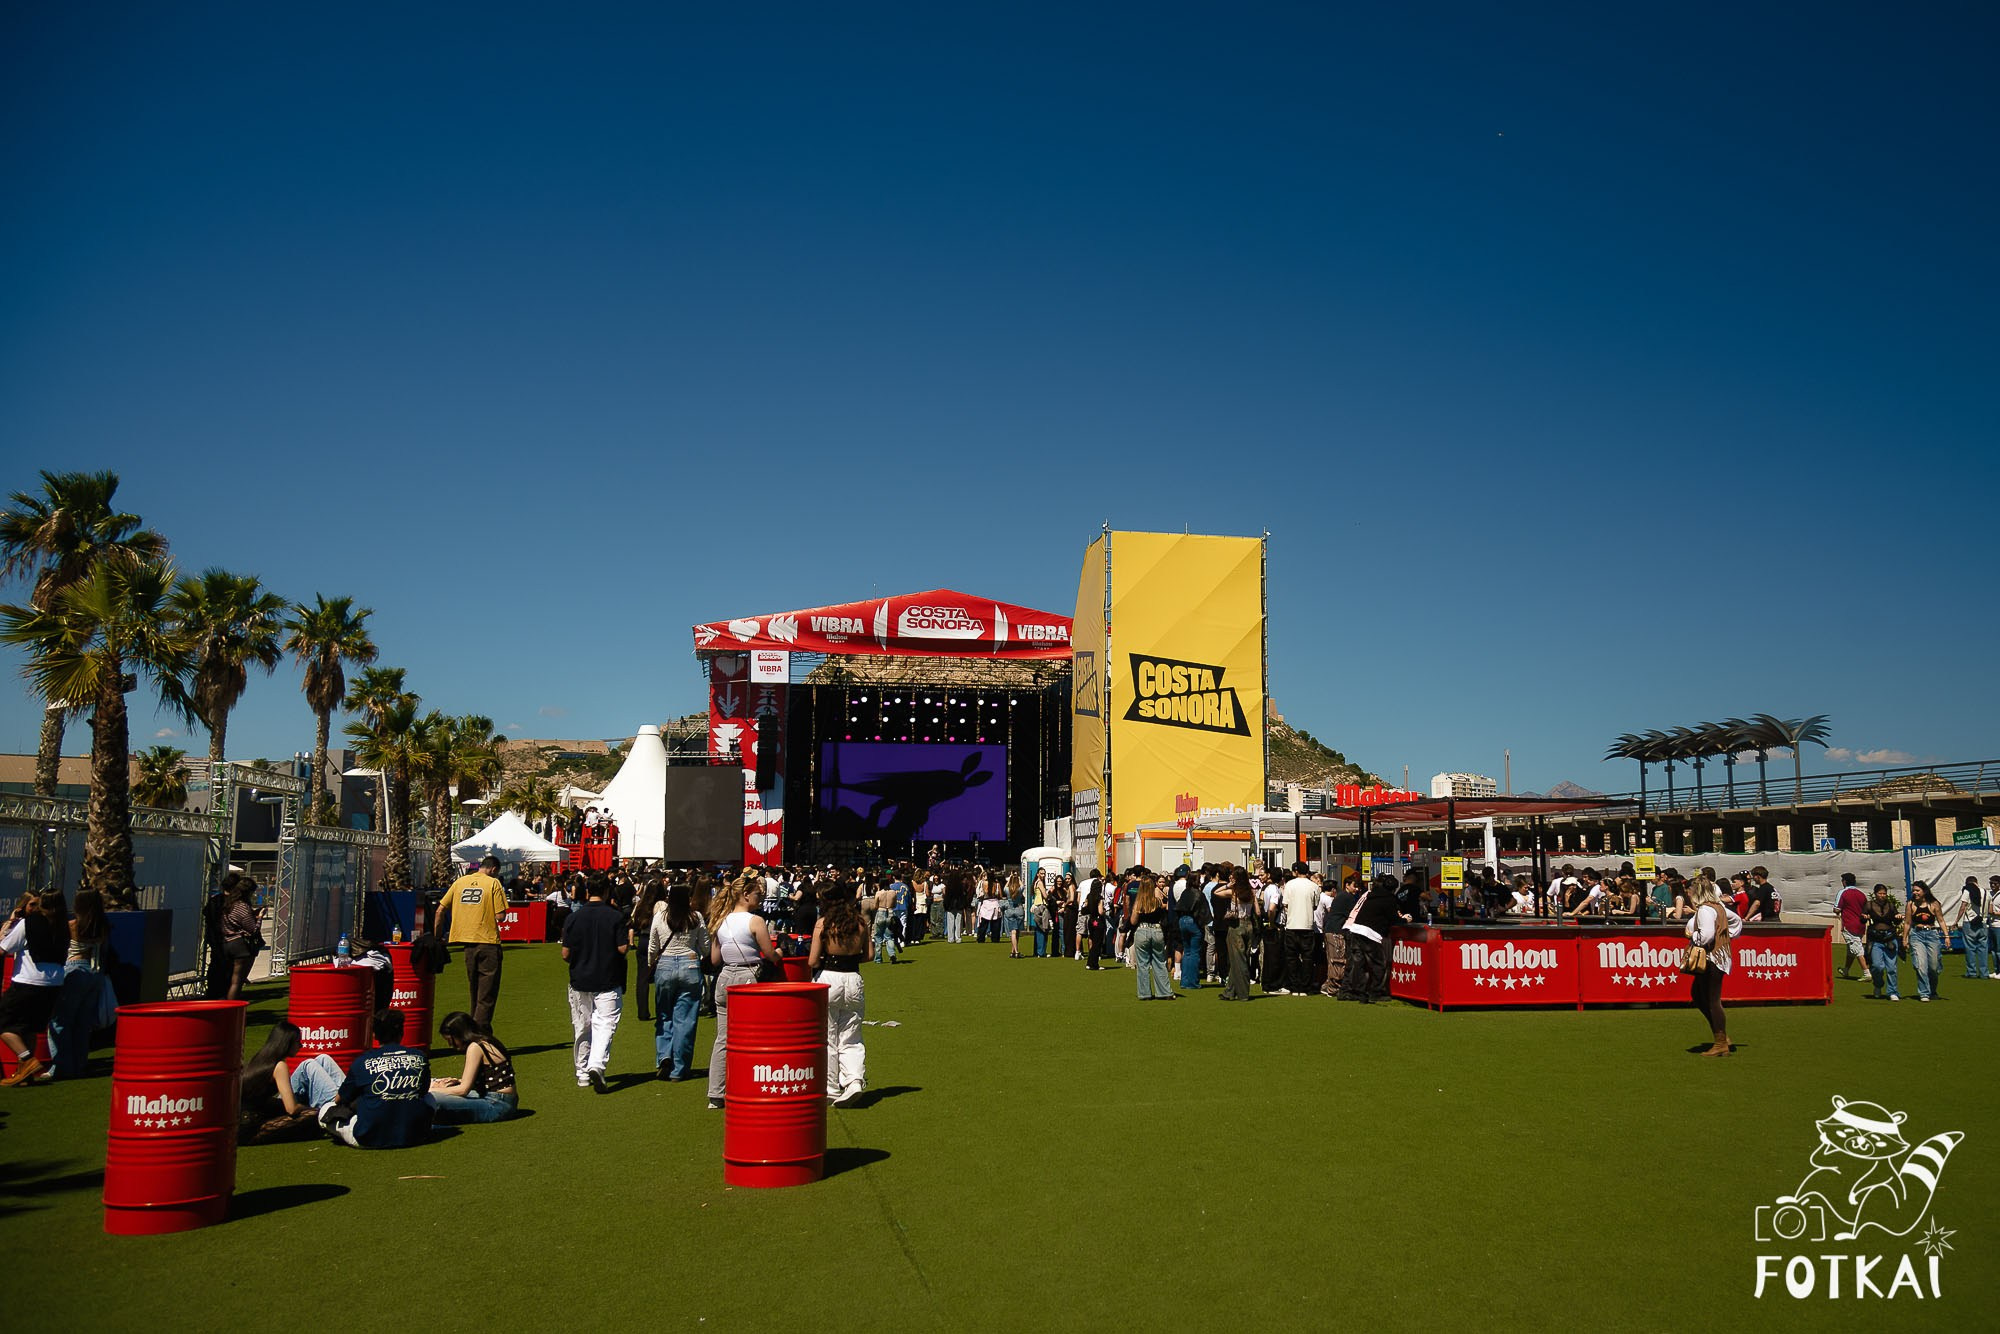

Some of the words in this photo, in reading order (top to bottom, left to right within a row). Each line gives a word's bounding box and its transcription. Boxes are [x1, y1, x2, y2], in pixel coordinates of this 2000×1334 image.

[907, 606, 969, 620] COSTA
[811, 616, 864, 634] VIBRA
[906, 618, 984, 631] SONORA
[1017, 625, 1069, 641] VIBRA
[1138, 661, 1216, 698] COSTA
[1138, 690, 1236, 729] SONORA
[1335, 783, 1418, 807] Mahou
[461, 888, 483, 904] 28
[1393, 941, 1423, 966] ahou
[1459, 942, 1558, 969] Mahou
[1739, 948, 1797, 967] Mahou
[753, 1064, 815, 1082] Mahou
[127, 1094, 204, 1115] Mahou
